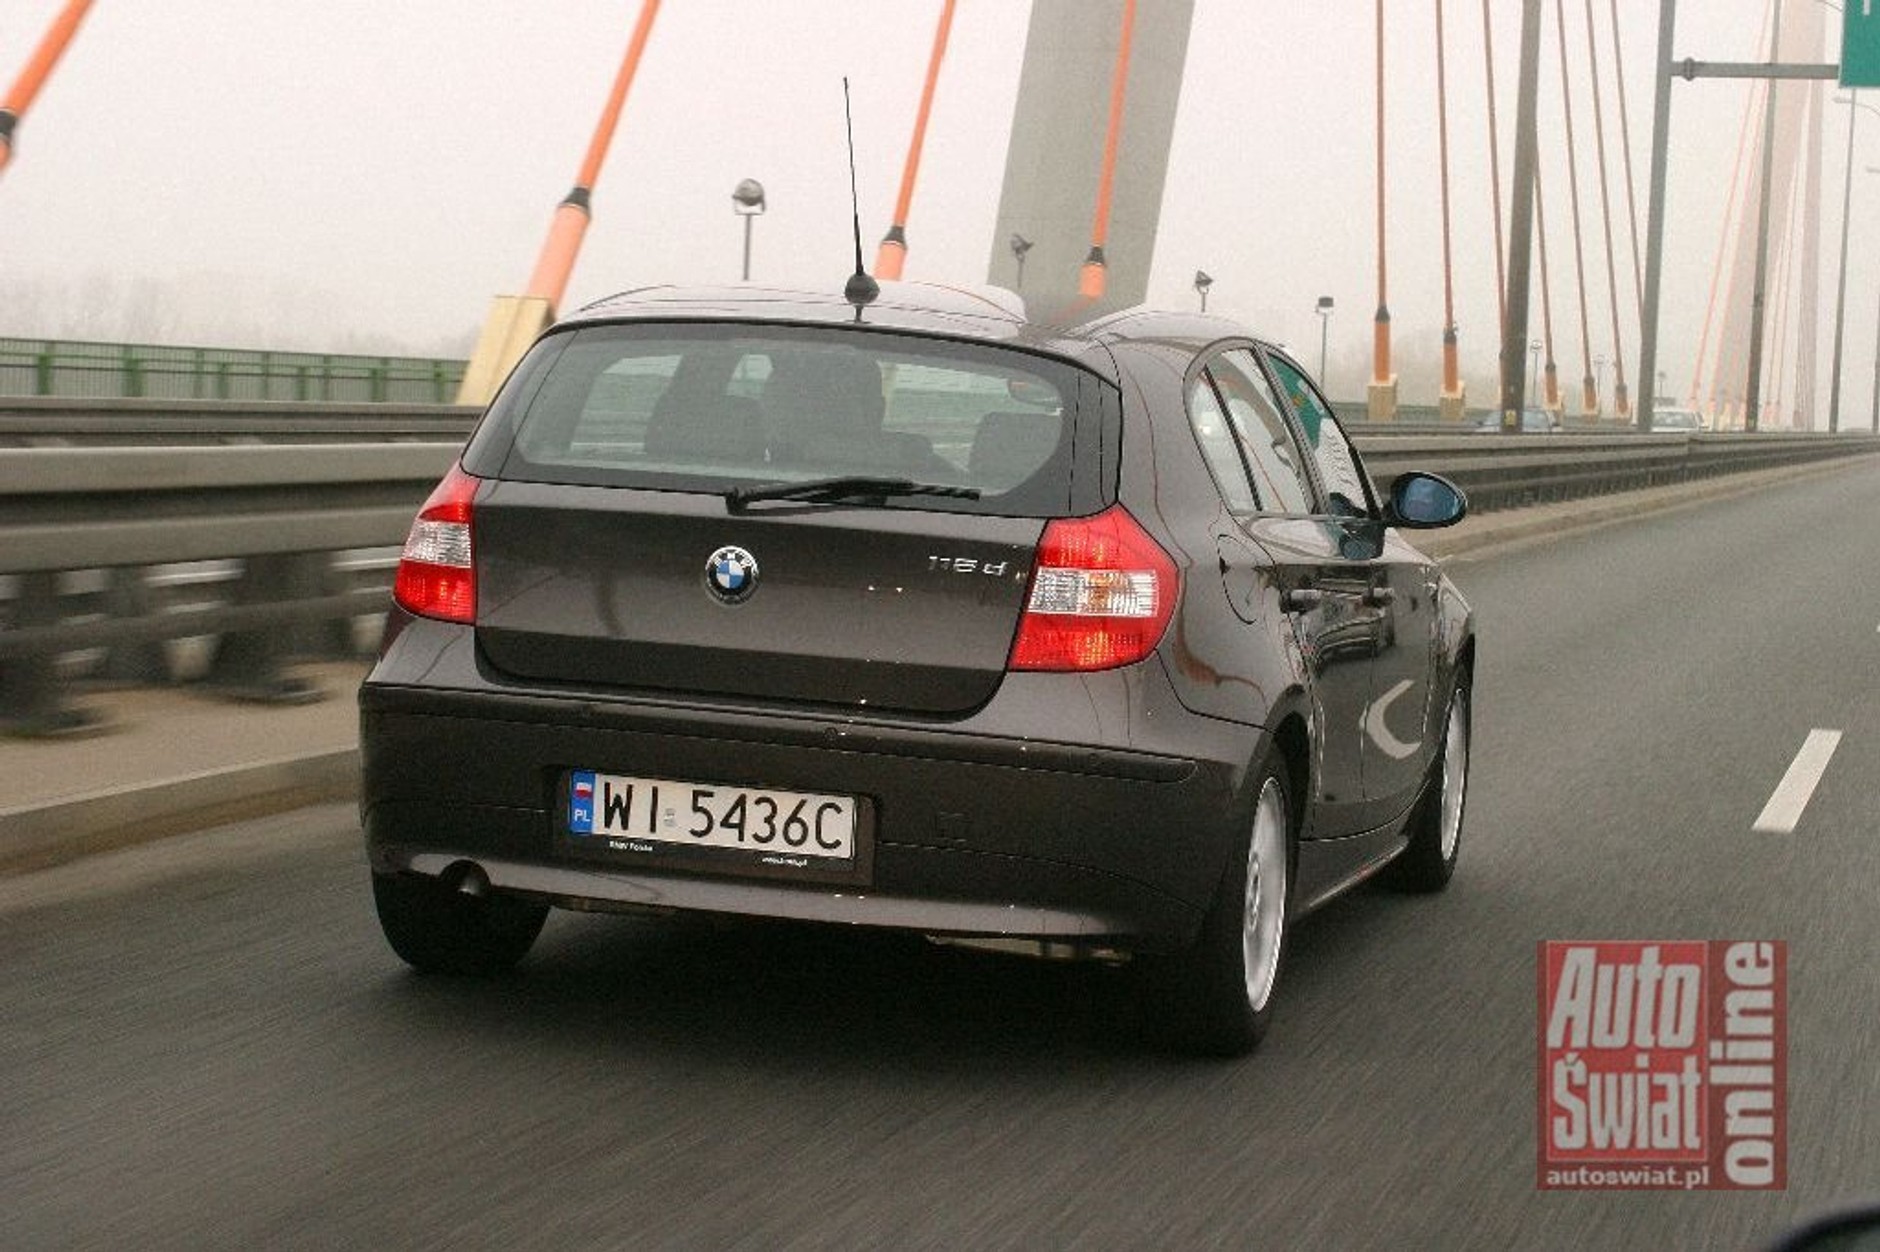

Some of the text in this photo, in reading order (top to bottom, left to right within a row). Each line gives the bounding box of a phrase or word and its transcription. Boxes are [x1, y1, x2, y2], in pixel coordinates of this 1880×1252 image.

[574, 808, 591, 823] PL
[603, 781, 843, 850] WI 5436C
